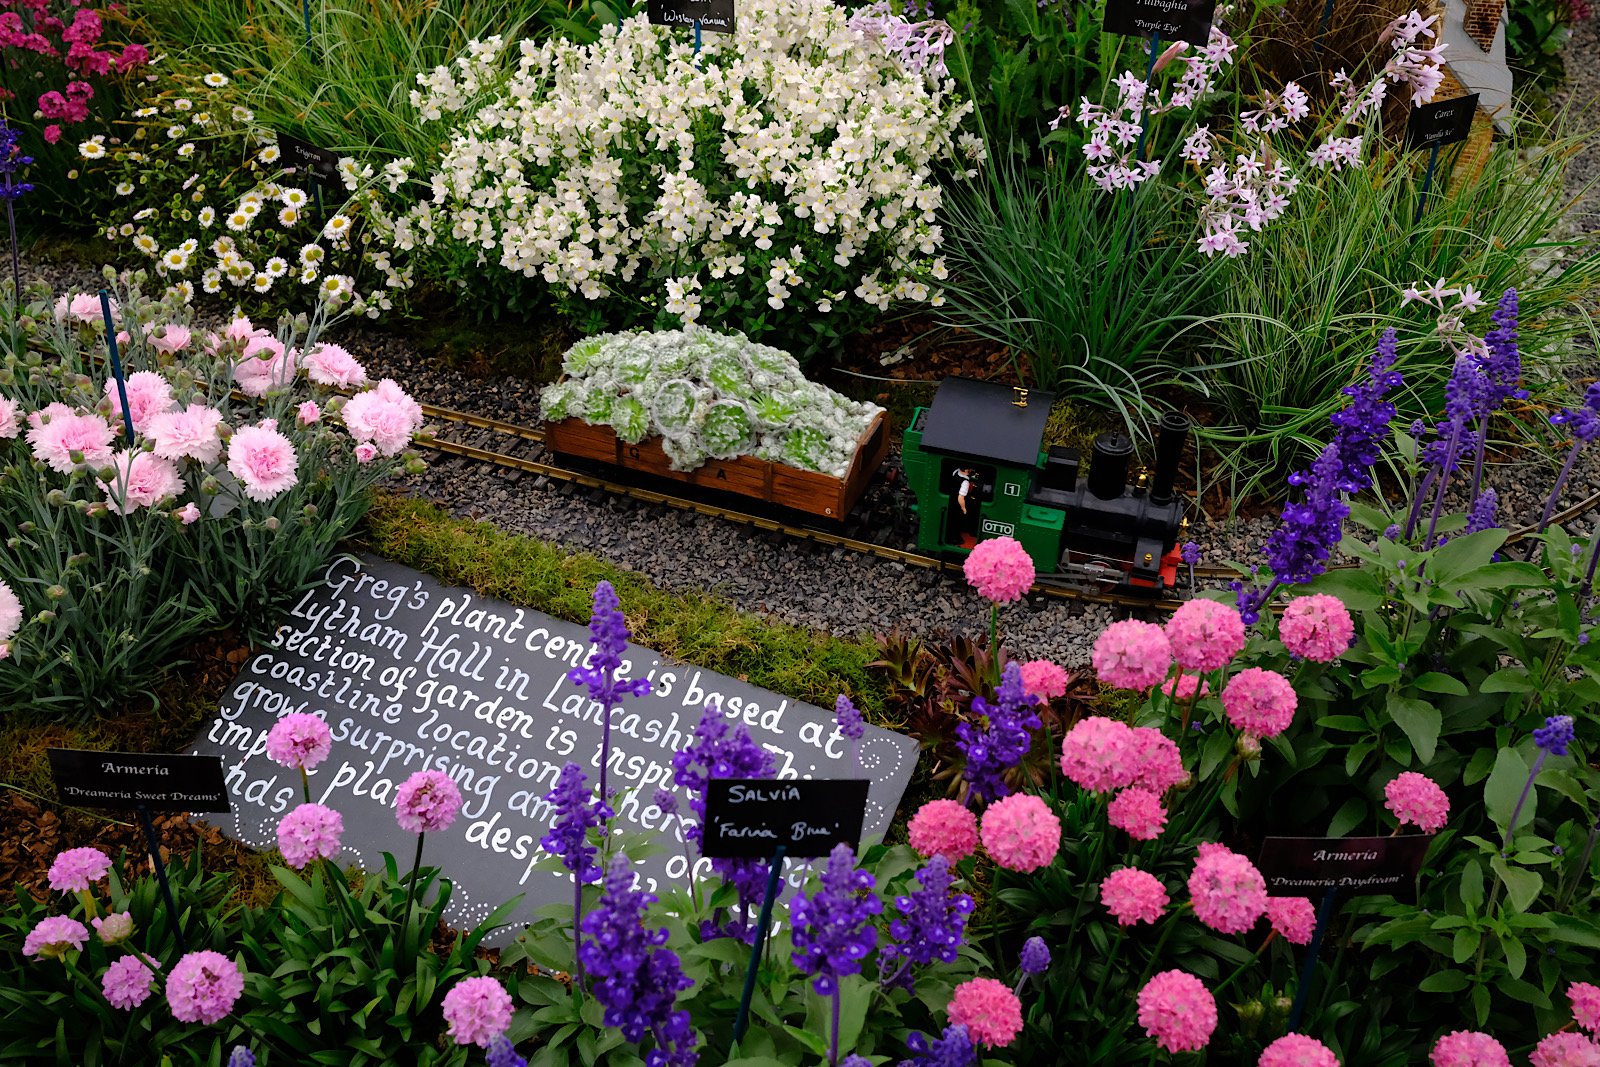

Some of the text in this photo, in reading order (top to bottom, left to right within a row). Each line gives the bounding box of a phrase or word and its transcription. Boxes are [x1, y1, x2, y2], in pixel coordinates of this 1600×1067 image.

[716, 468, 727, 480] A
[1009, 485, 1015, 494] 1
[984, 522, 1012, 535] OTTO
[290, 589, 408, 660] Lytham
[414, 626, 492, 682] Hall
[495, 657, 530, 701] in
[325, 557, 845, 759] Greg's plant cente is based at
[251, 654, 403, 724] coastline
[271, 625, 376, 681] section
[379, 666, 417, 702] of
[412, 680, 534, 739] garden
[546, 718, 578, 756] is
[101, 762, 169, 776] Armeria
[135, 790, 167, 801] Sweet
[1313, 849, 1378, 861] Armeria
